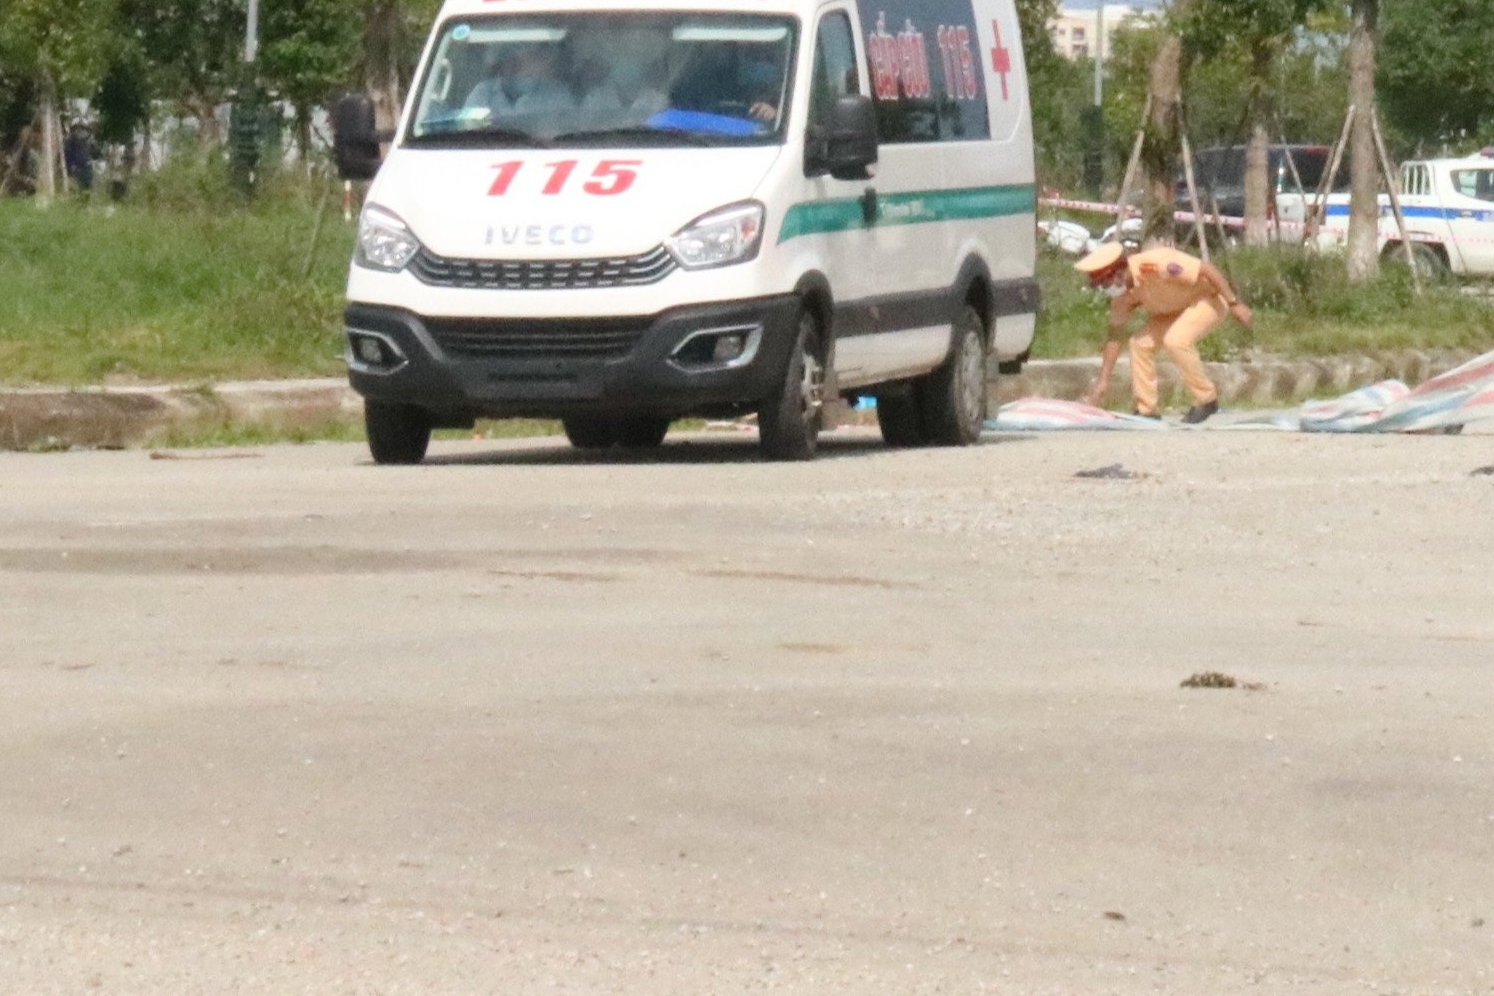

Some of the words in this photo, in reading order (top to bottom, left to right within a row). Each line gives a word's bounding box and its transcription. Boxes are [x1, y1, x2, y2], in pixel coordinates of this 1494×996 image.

[936, 23, 977, 101] 115
[486, 158, 645, 197] 115
[484, 223, 595, 246] IVECO
